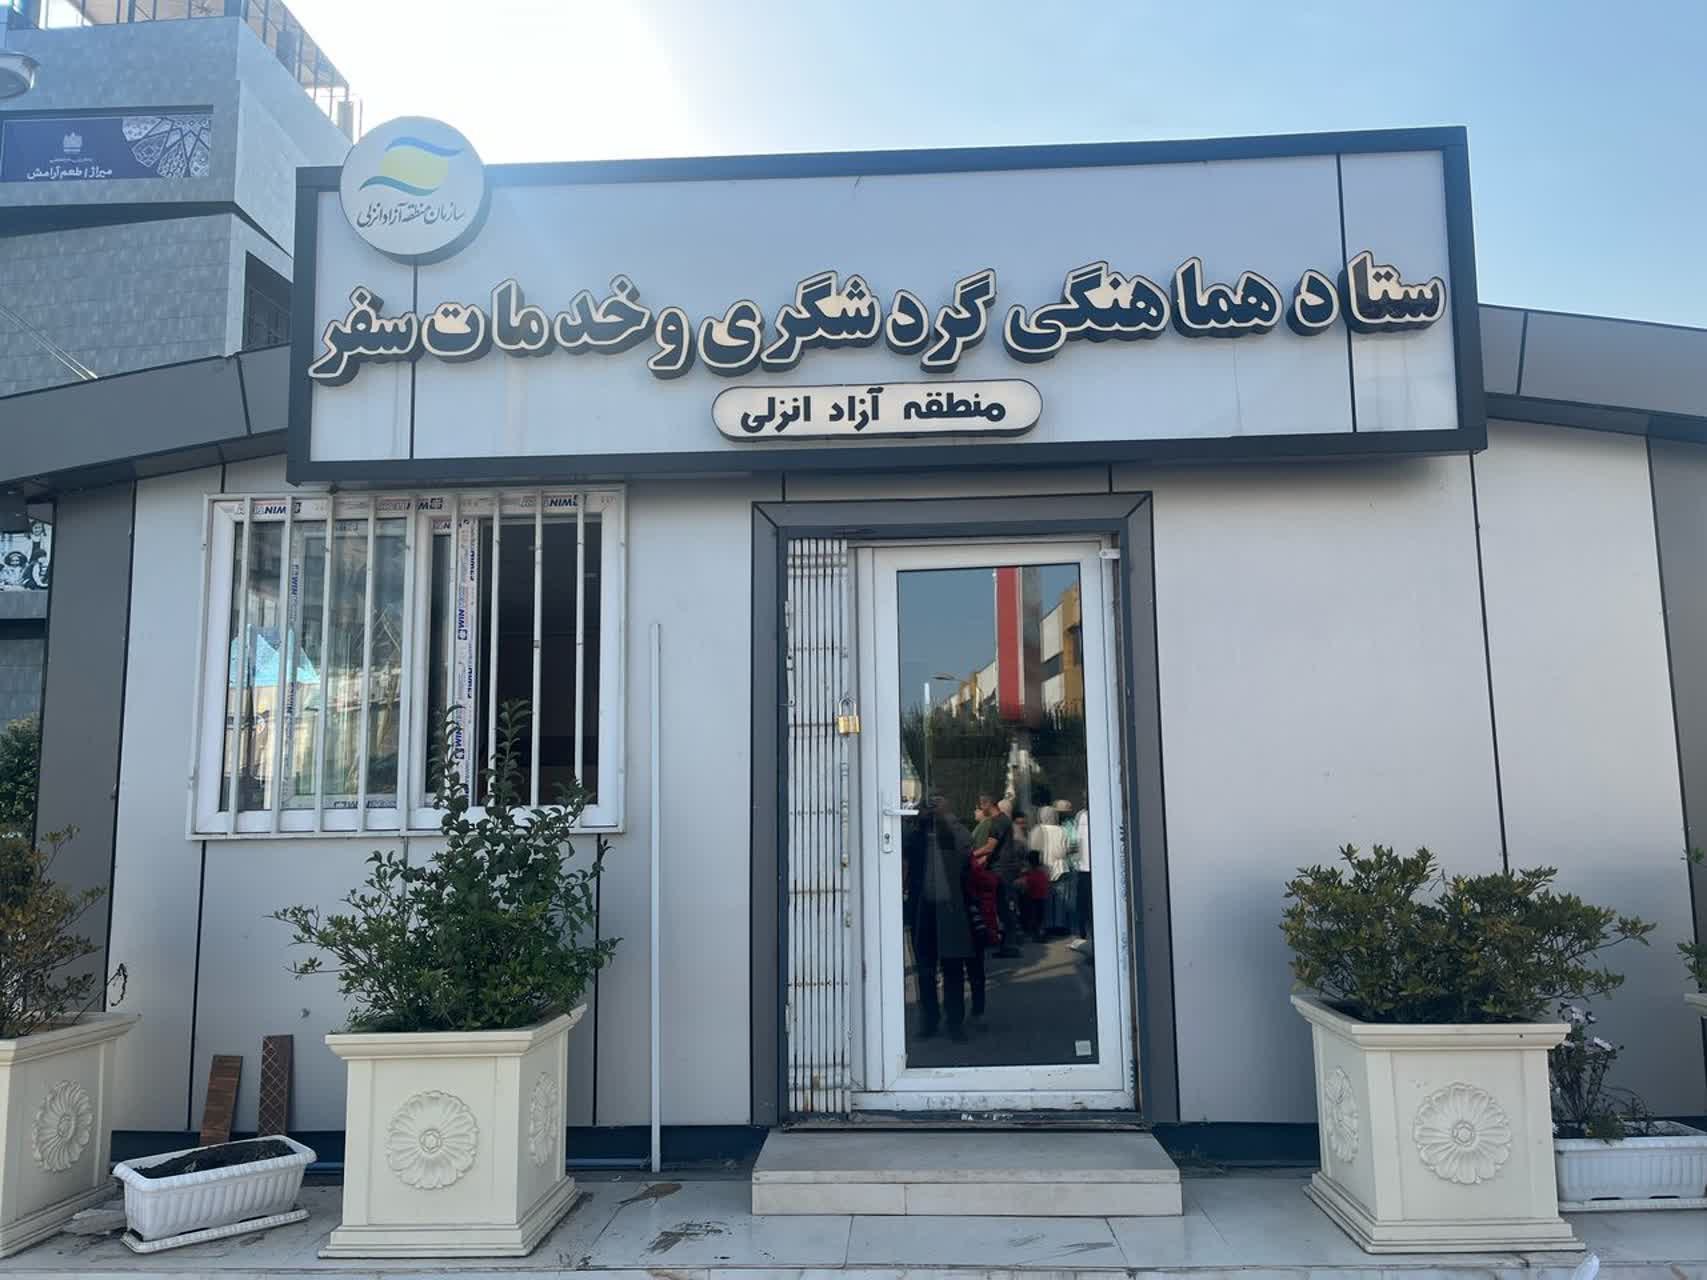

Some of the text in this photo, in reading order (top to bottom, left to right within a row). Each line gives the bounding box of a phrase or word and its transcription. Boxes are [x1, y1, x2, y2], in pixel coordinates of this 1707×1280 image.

[356, 201, 465, 228] سازمان منطقه آزاد انزلی
[307, 250, 1447, 380] ستاد هماهنگی گردشگری و خدمات سفر
[740, 386, 1007, 433] منطقه آزاد انزلی
